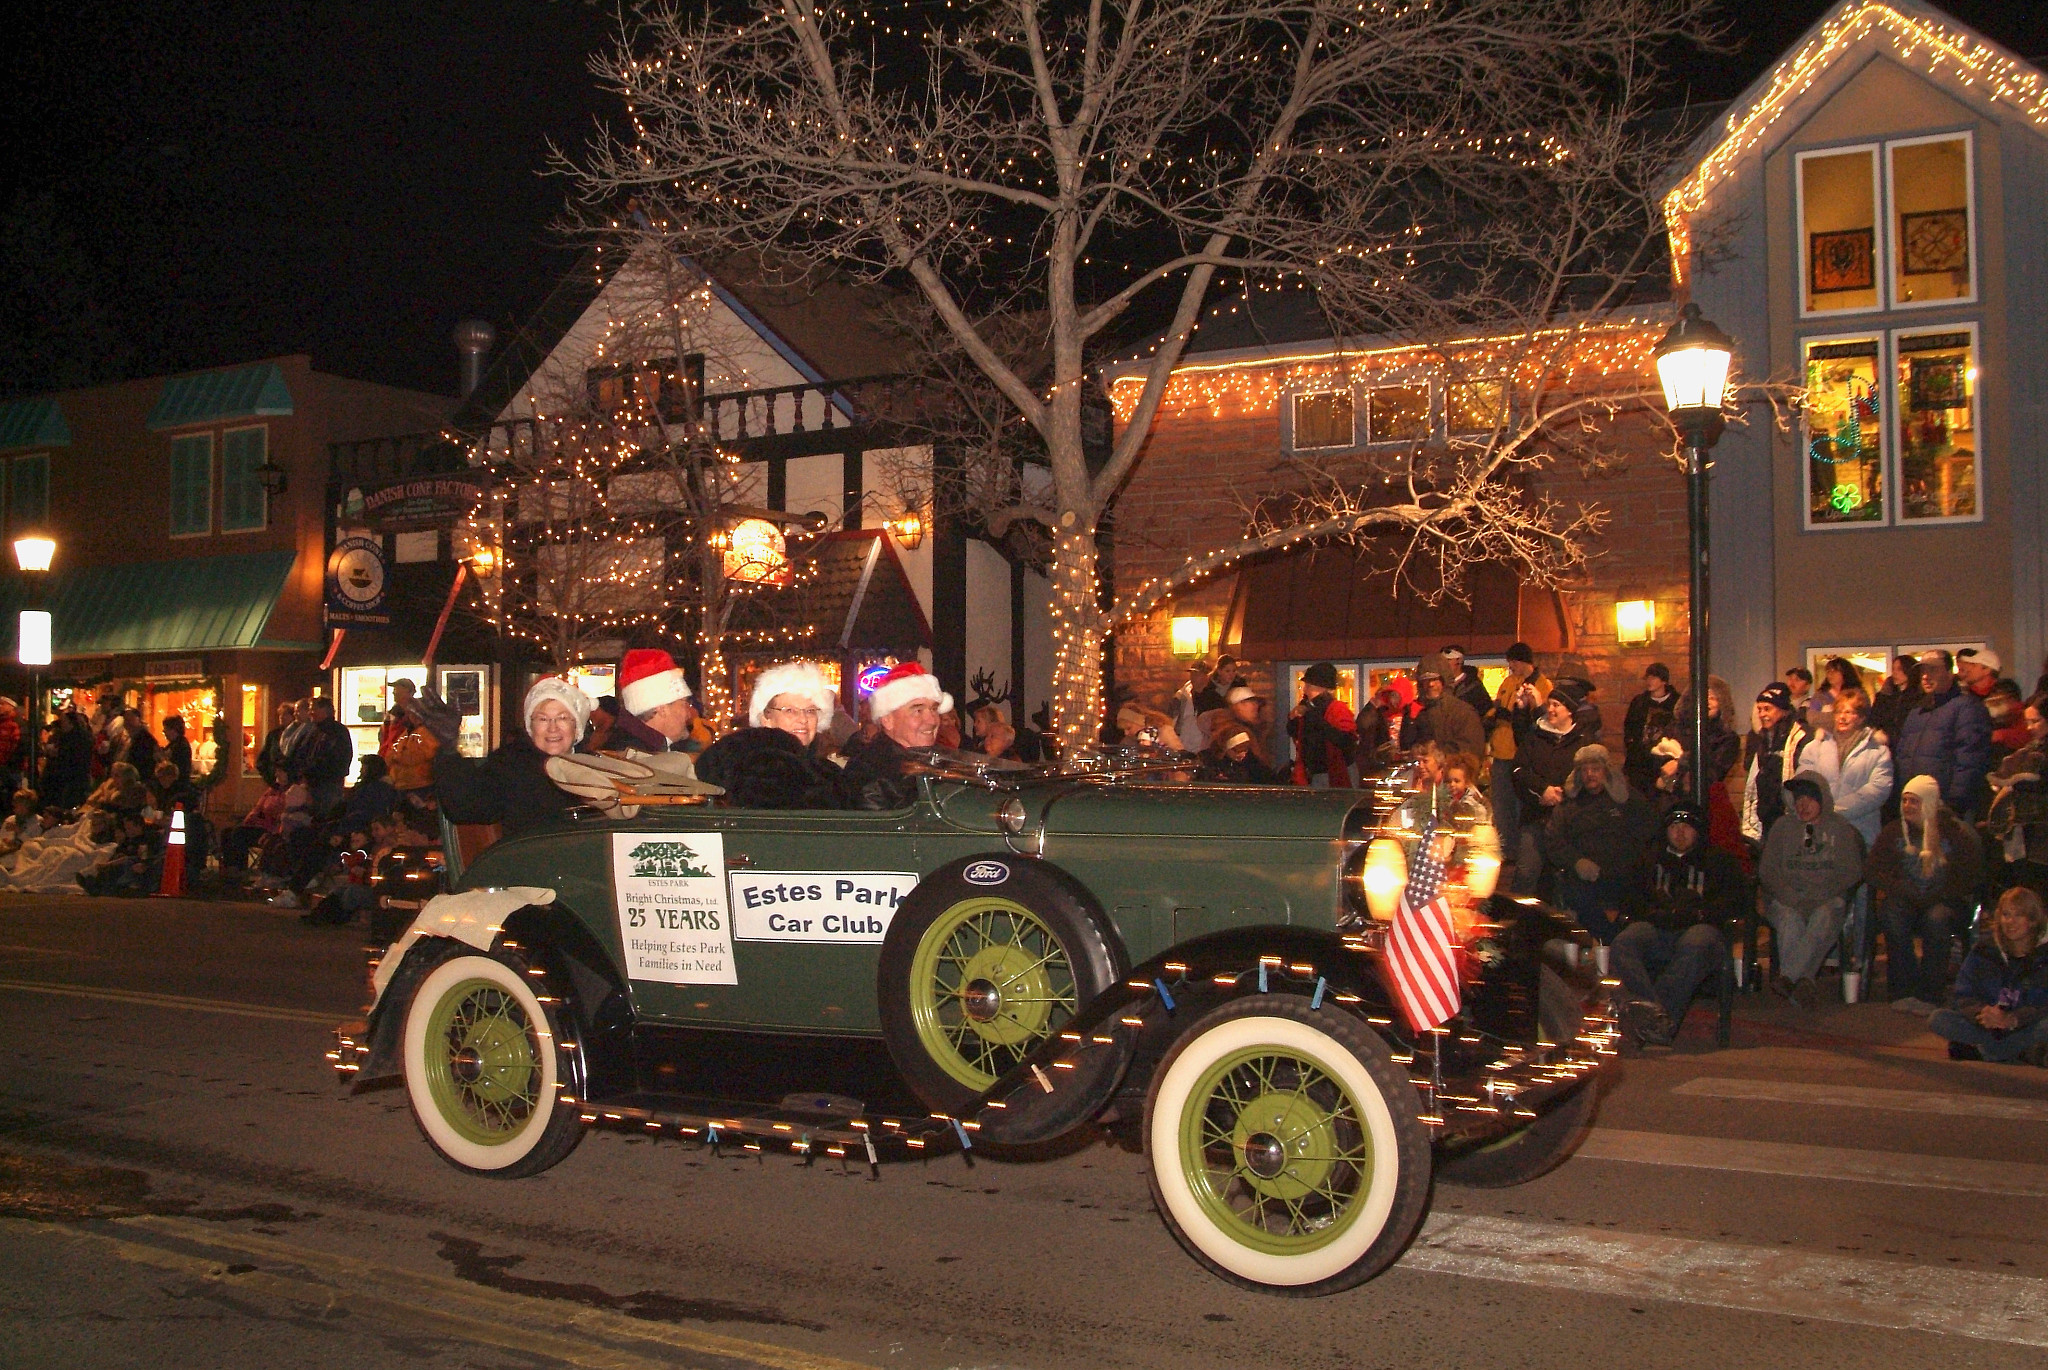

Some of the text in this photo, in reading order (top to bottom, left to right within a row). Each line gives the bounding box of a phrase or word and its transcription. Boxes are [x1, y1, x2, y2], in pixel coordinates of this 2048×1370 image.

[365, 484, 405, 510] DANISH
[406, 480, 434, 498] CONE
[329, 612, 390, 624] MALTS SMOOTHIES
[970, 864, 1001, 879] Ford
[625, 892, 652, 905] Bright
[654, 894, 704, 906] Christmas,
[742, 880, 907, 909] Estes Park
[628, 907, 721, 930] 25 YEARS
[768, 914, 883, 934] Car Club
[631, 939, 726, 955] Helping Estes Park
[639, 956, 722, 971] Families in Need
